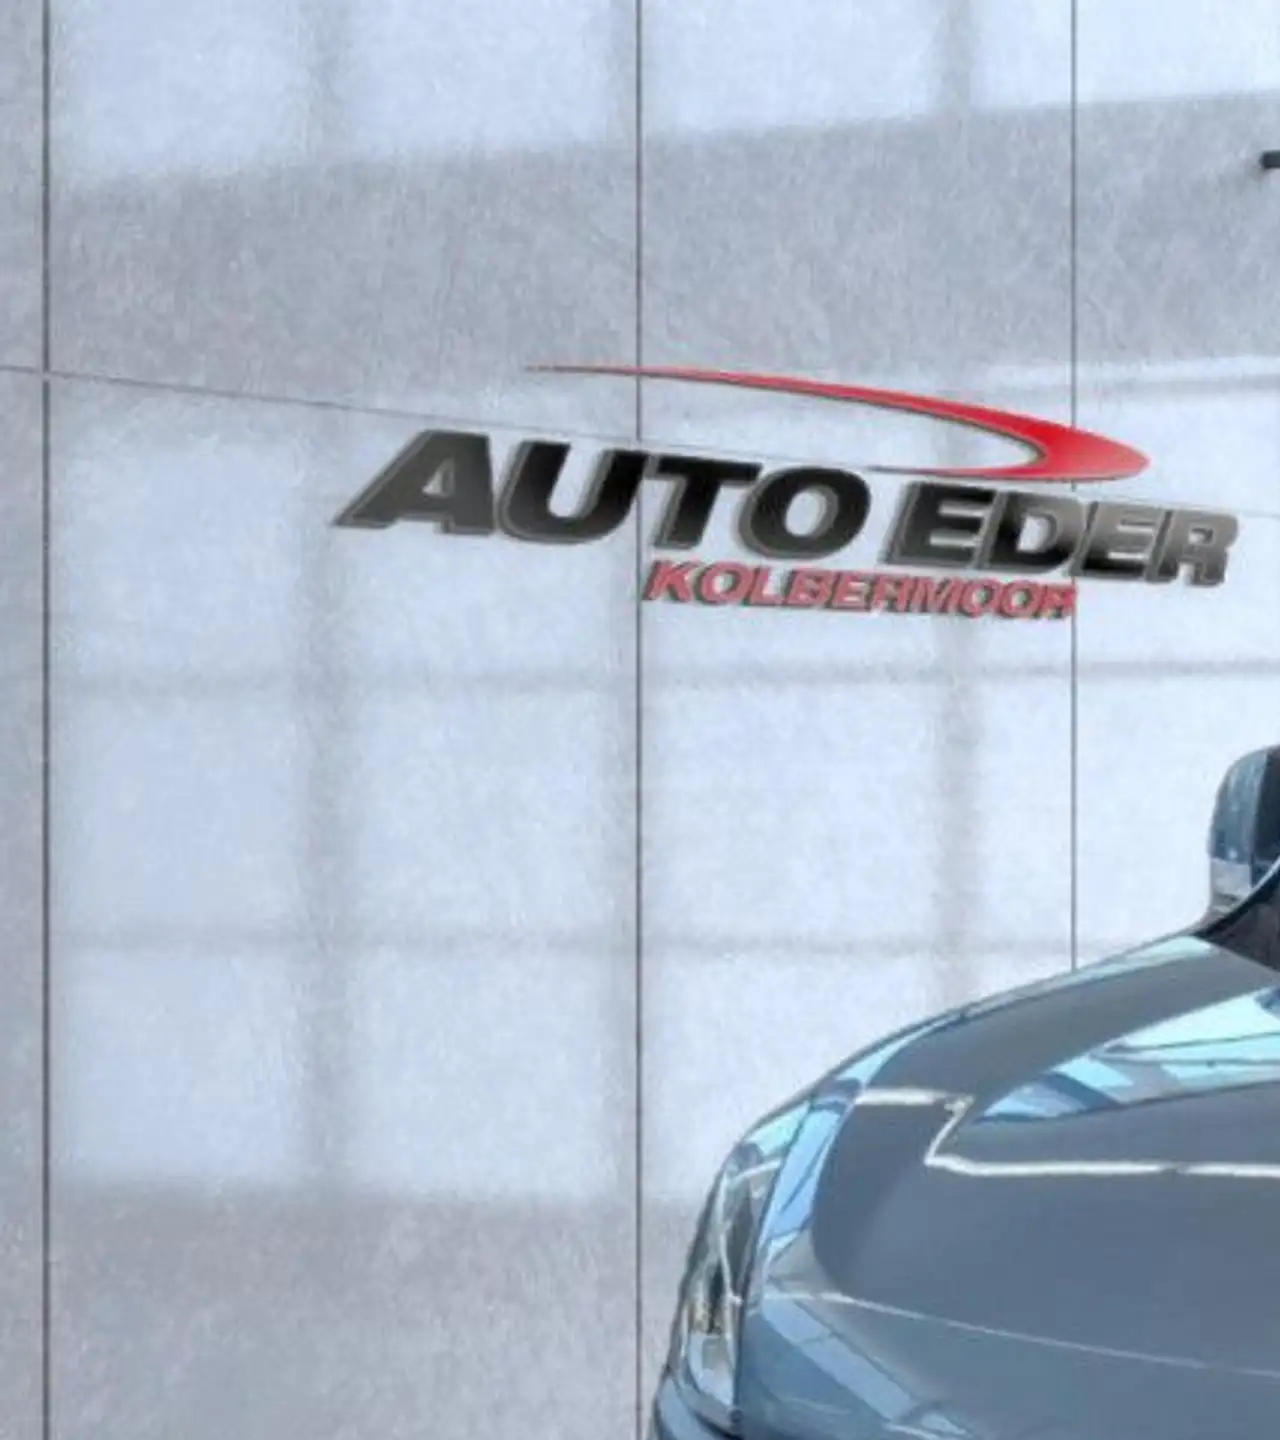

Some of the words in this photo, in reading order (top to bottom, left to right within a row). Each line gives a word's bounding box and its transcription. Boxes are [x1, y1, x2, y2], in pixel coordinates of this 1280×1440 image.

[333, 429, 872, 562] AUTO
[883, 479, 1240, 587] EDER
[642, 559, 1078, 620] KOLBERMOOR
